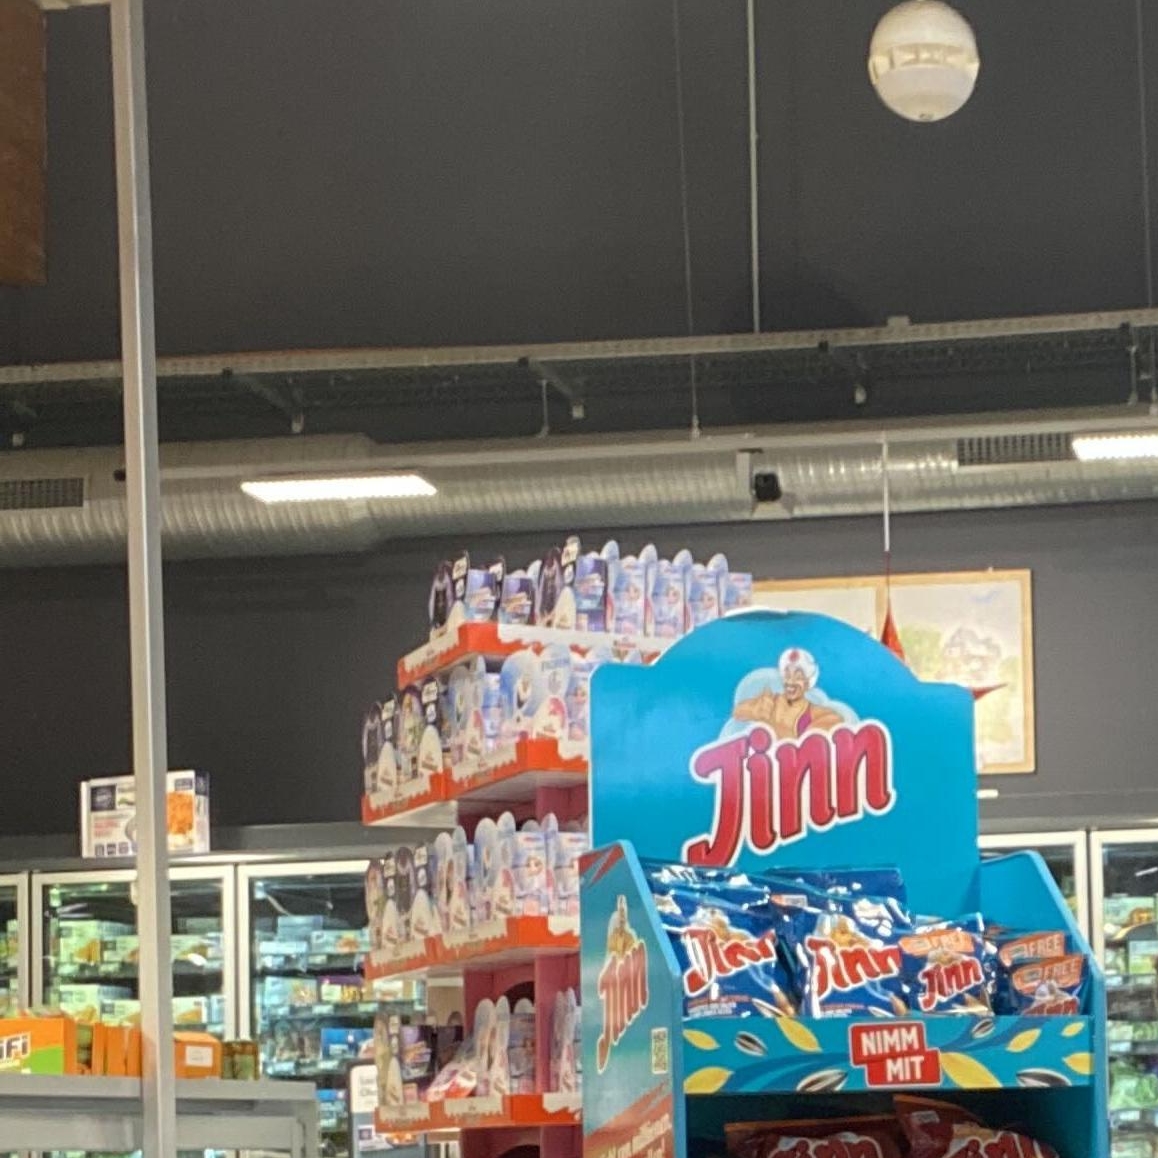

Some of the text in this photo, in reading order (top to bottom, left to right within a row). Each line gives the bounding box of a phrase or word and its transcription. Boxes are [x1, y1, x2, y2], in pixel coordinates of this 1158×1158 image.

[683, 720, 895, 867] Jinn
[1029, 933, 1062, 954] FREE
[919, 957, 984, 1011] Jinn
[1044, 957, 1082, 982] FREE
[597, 938, 649, 1075] Jinn
[861, 1026, 920, 1056] NIMM
[886, 1055, 925, 1082] MIT
